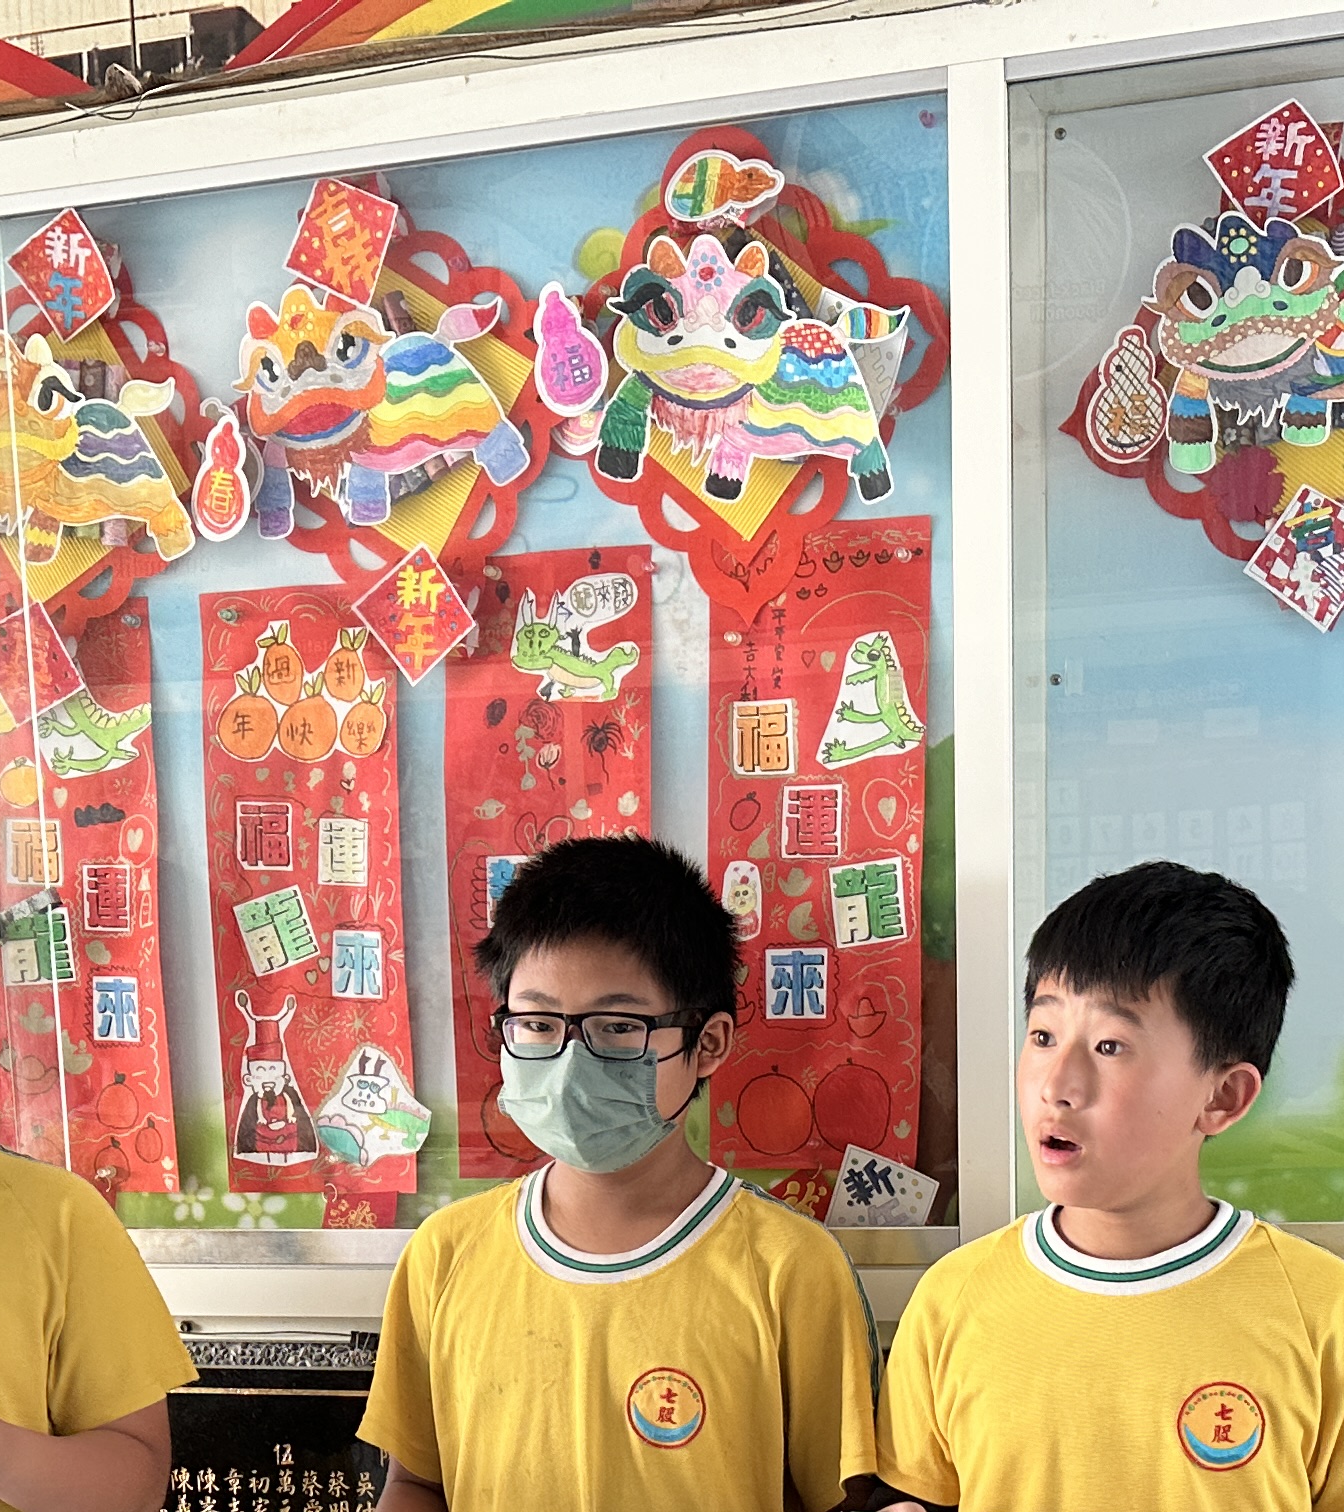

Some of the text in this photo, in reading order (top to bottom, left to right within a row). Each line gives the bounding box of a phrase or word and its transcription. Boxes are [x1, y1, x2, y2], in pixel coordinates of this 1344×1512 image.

[1245, 119, 1316, 218] 新年
[44, 229, 91, 329] 新年
[209, 468, 234, 514] 春
[395, 565, 446, 671] 新年
[1210, 1402, 1236, 1444] 七股
